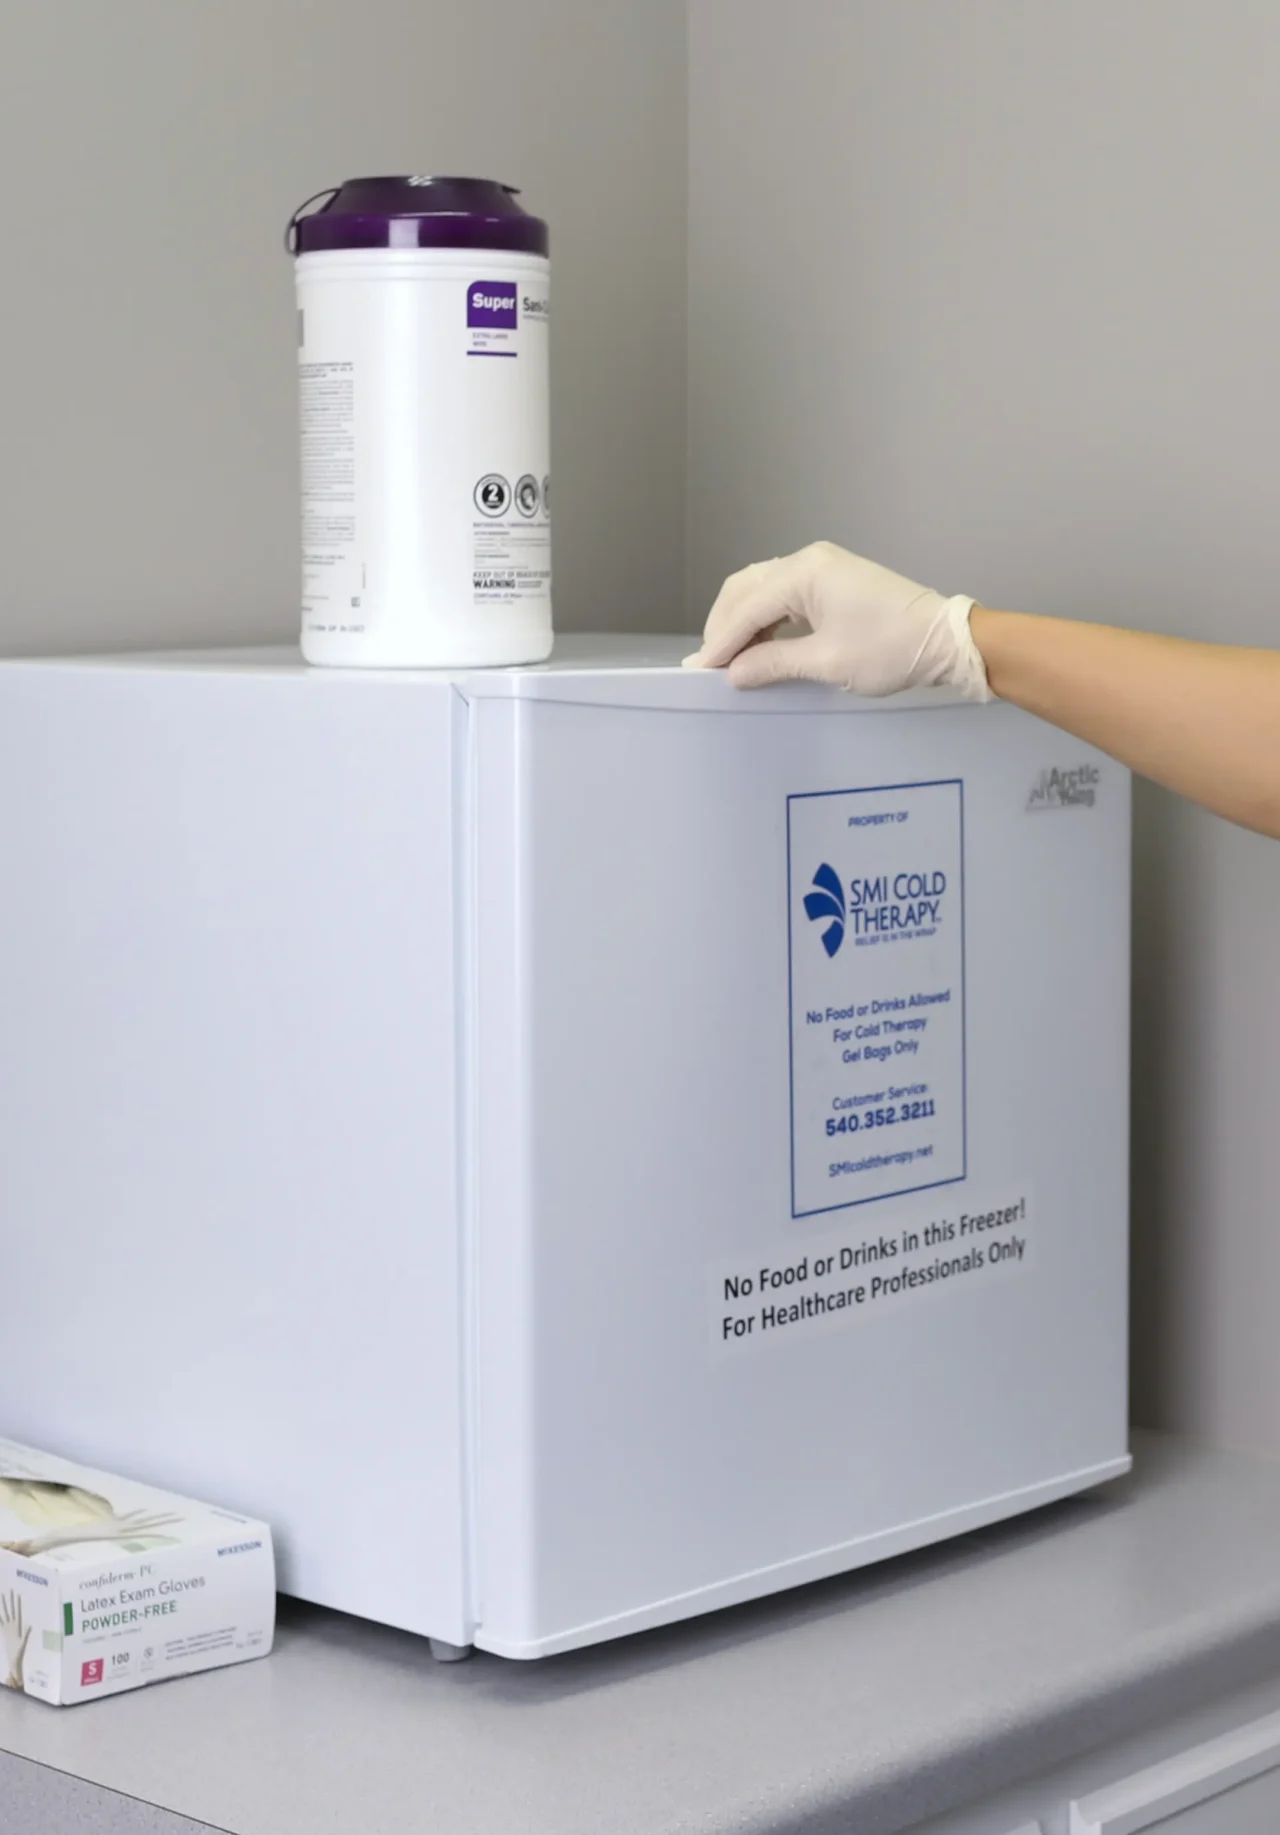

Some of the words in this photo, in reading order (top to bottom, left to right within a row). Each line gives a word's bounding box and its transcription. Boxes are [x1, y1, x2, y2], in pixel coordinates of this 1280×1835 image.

[472, 292, 515, 312] Super
[487, 484, 499, 502] 2
[473, 579, 516, 589] WARNING
[848, 813, 895, 828] PROPERTY
[896, 810, 909, 823] OF
[850, 875, 888, 906] SMI
[893, 871, 947, 900] COLD
[850, 899, 940, 934] THERAPY
[806, 1010, 823, 1025] No
[825, 1004, 855, 1021] Food
[857, 1005, 869, 1017] or
[871, 997, 906, 1015] Drinks
[908, 988, 951, 1008] Allowed
[833, 1027, 852, 1043] For
[855, 1022, 880, 1040] Cold
[883, 1017, 928, 1035] Therapy
[842, 1048, 861, 1063] Gel
[863, 1044, 892, 1062] Bags
[894, 1039, 919, 1055] Only
[832, 1092, 885, 1111] Customer
[826, 1098, 935, 1136] 540.352.3211
[724, 1276, 753, 1300] No
[760, 1259, 808, 1291] Food
[814, 1256, 833, 1276] or
[840, 1237, 897, 1269] Drinks
[902, 1231, 919, 1252] in
[923, 1221, 955, 1247] this
[960, 1197, 1026, 1237] Freezer!
[723, 1314, 754, 1340] For
[761, 1285, 865, 1330] Healthcare
[871, 1246, 984, 1299] Professionals
[989, 1236, 1026, 1263] Only
[80, 1596, 116, 1613] Latex
[119, 1587, 155, 1604] Exam
[158, 1576, 206, 1595] Gloves
[82, 1600, 178, 1633] POWDER-FREE
[88, 1662, 97, 1675] S
[111, 1652, 130, 1666] 100
